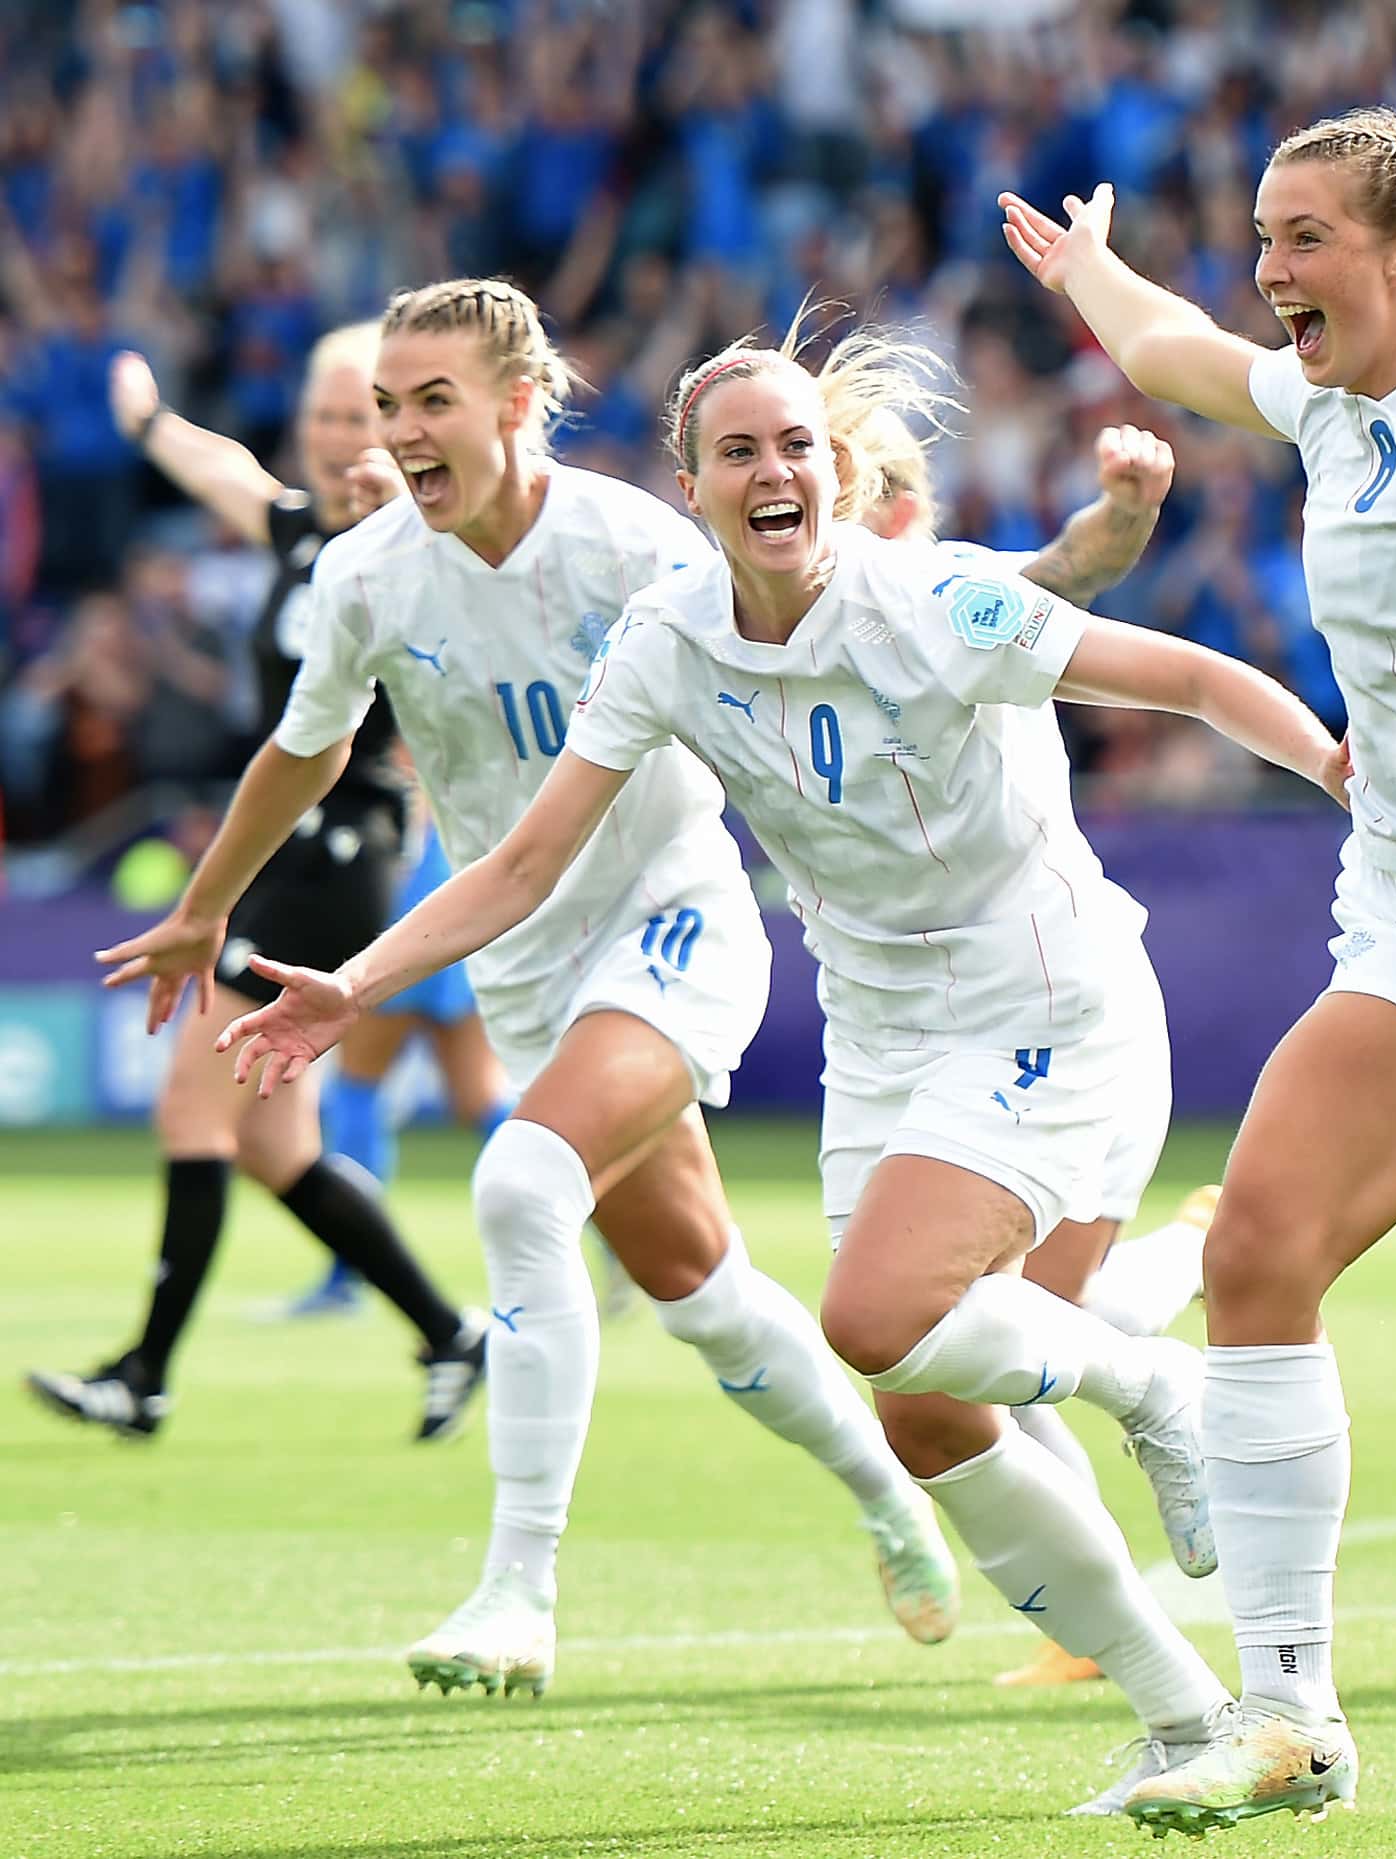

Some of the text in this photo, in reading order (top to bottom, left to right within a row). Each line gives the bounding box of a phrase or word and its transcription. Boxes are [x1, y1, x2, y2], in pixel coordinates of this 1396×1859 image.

[495, 680, 566, 760] 10
[809, 703, 844, 804] 9
[640, 908, 704, 972] 10
[1278, 1645, 1298, 1674] IGN
